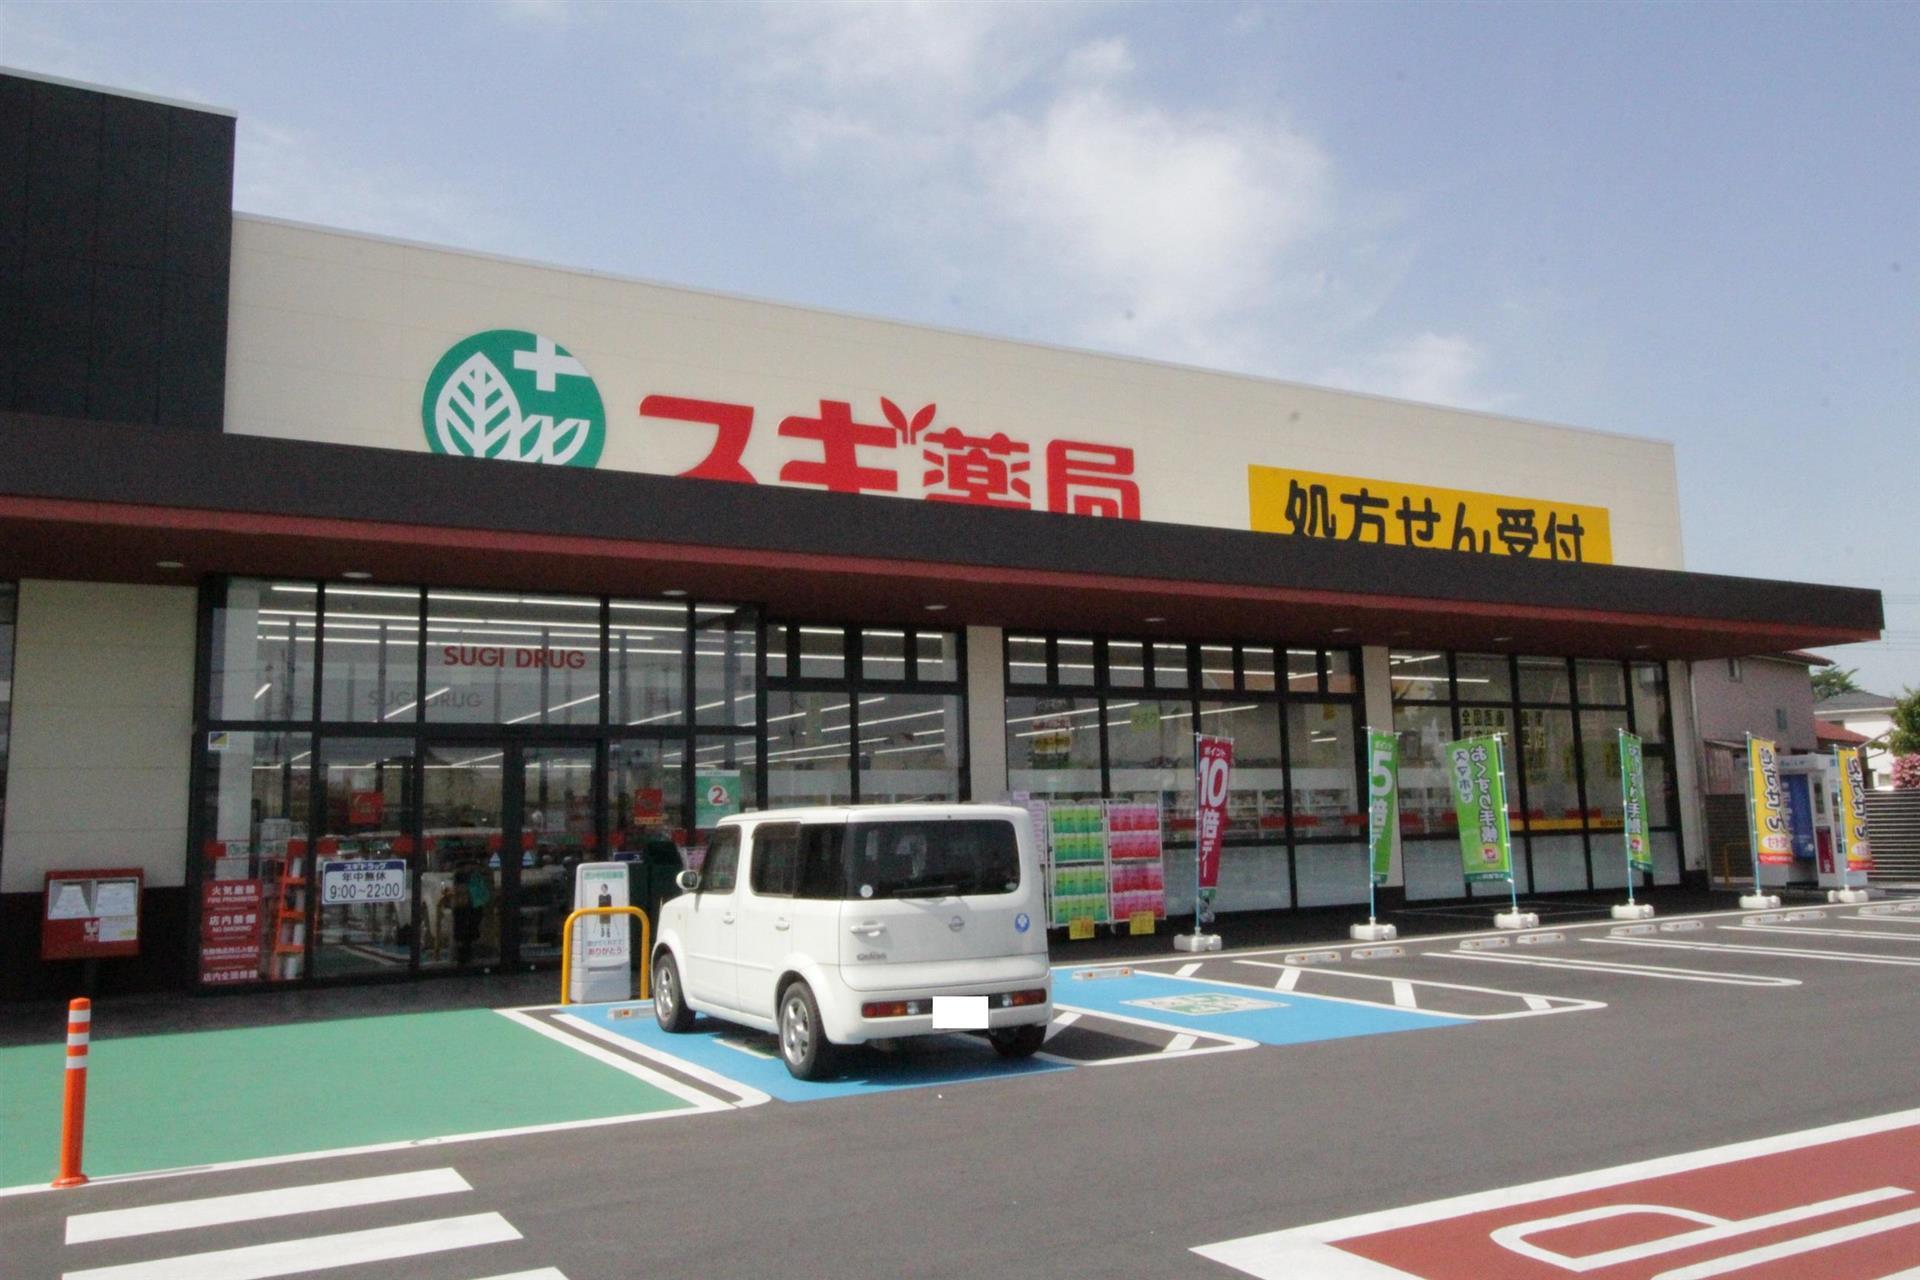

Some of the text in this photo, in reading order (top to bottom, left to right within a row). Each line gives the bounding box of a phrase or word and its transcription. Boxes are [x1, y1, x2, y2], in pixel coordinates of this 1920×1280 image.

[1285, 479, 1585, 563] 処方せん受付
[444, 646, 585, 669] SUGI DRUG
[1200, 757, 1229, 808] 10
[1372, 751, 1393, 797] 5
[342, 872, 386, 881] 年中無休
